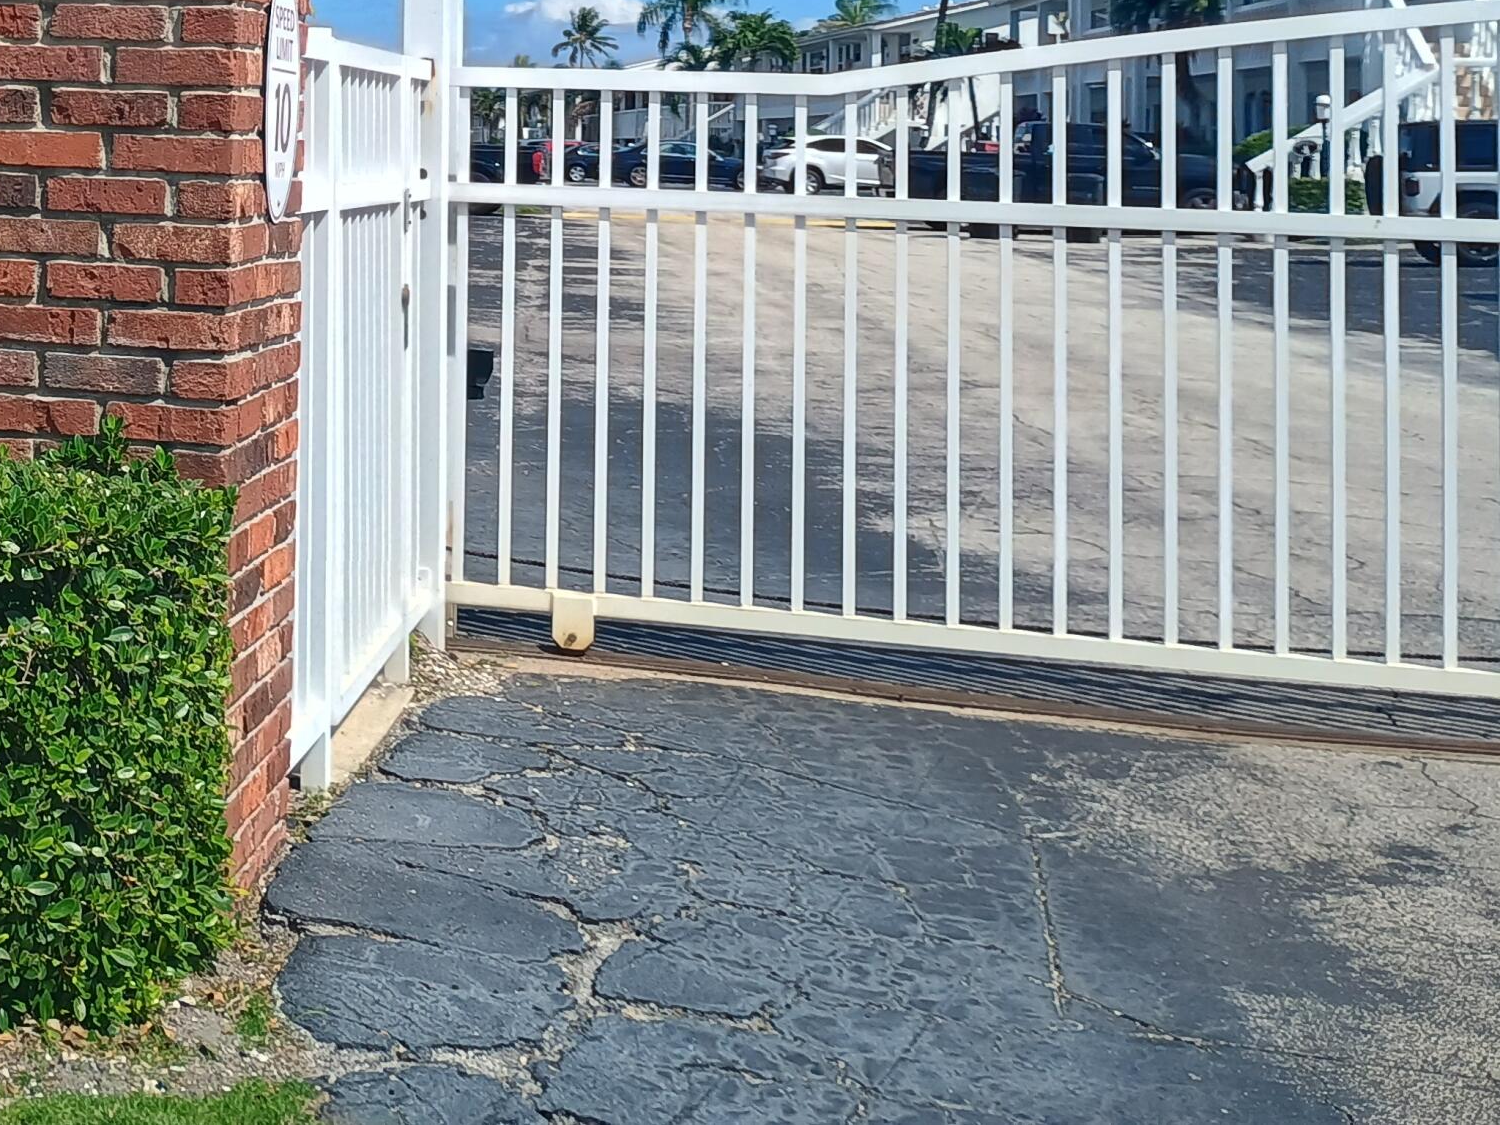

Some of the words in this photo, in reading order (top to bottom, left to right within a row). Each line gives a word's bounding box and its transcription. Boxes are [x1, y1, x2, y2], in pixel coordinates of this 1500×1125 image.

[275, 5, 294, 32] SPEED
[276, 37, 293, 62] LIMIT
[274, 83, 291, 153] 10
[275, 162, 285, 178] MPH
